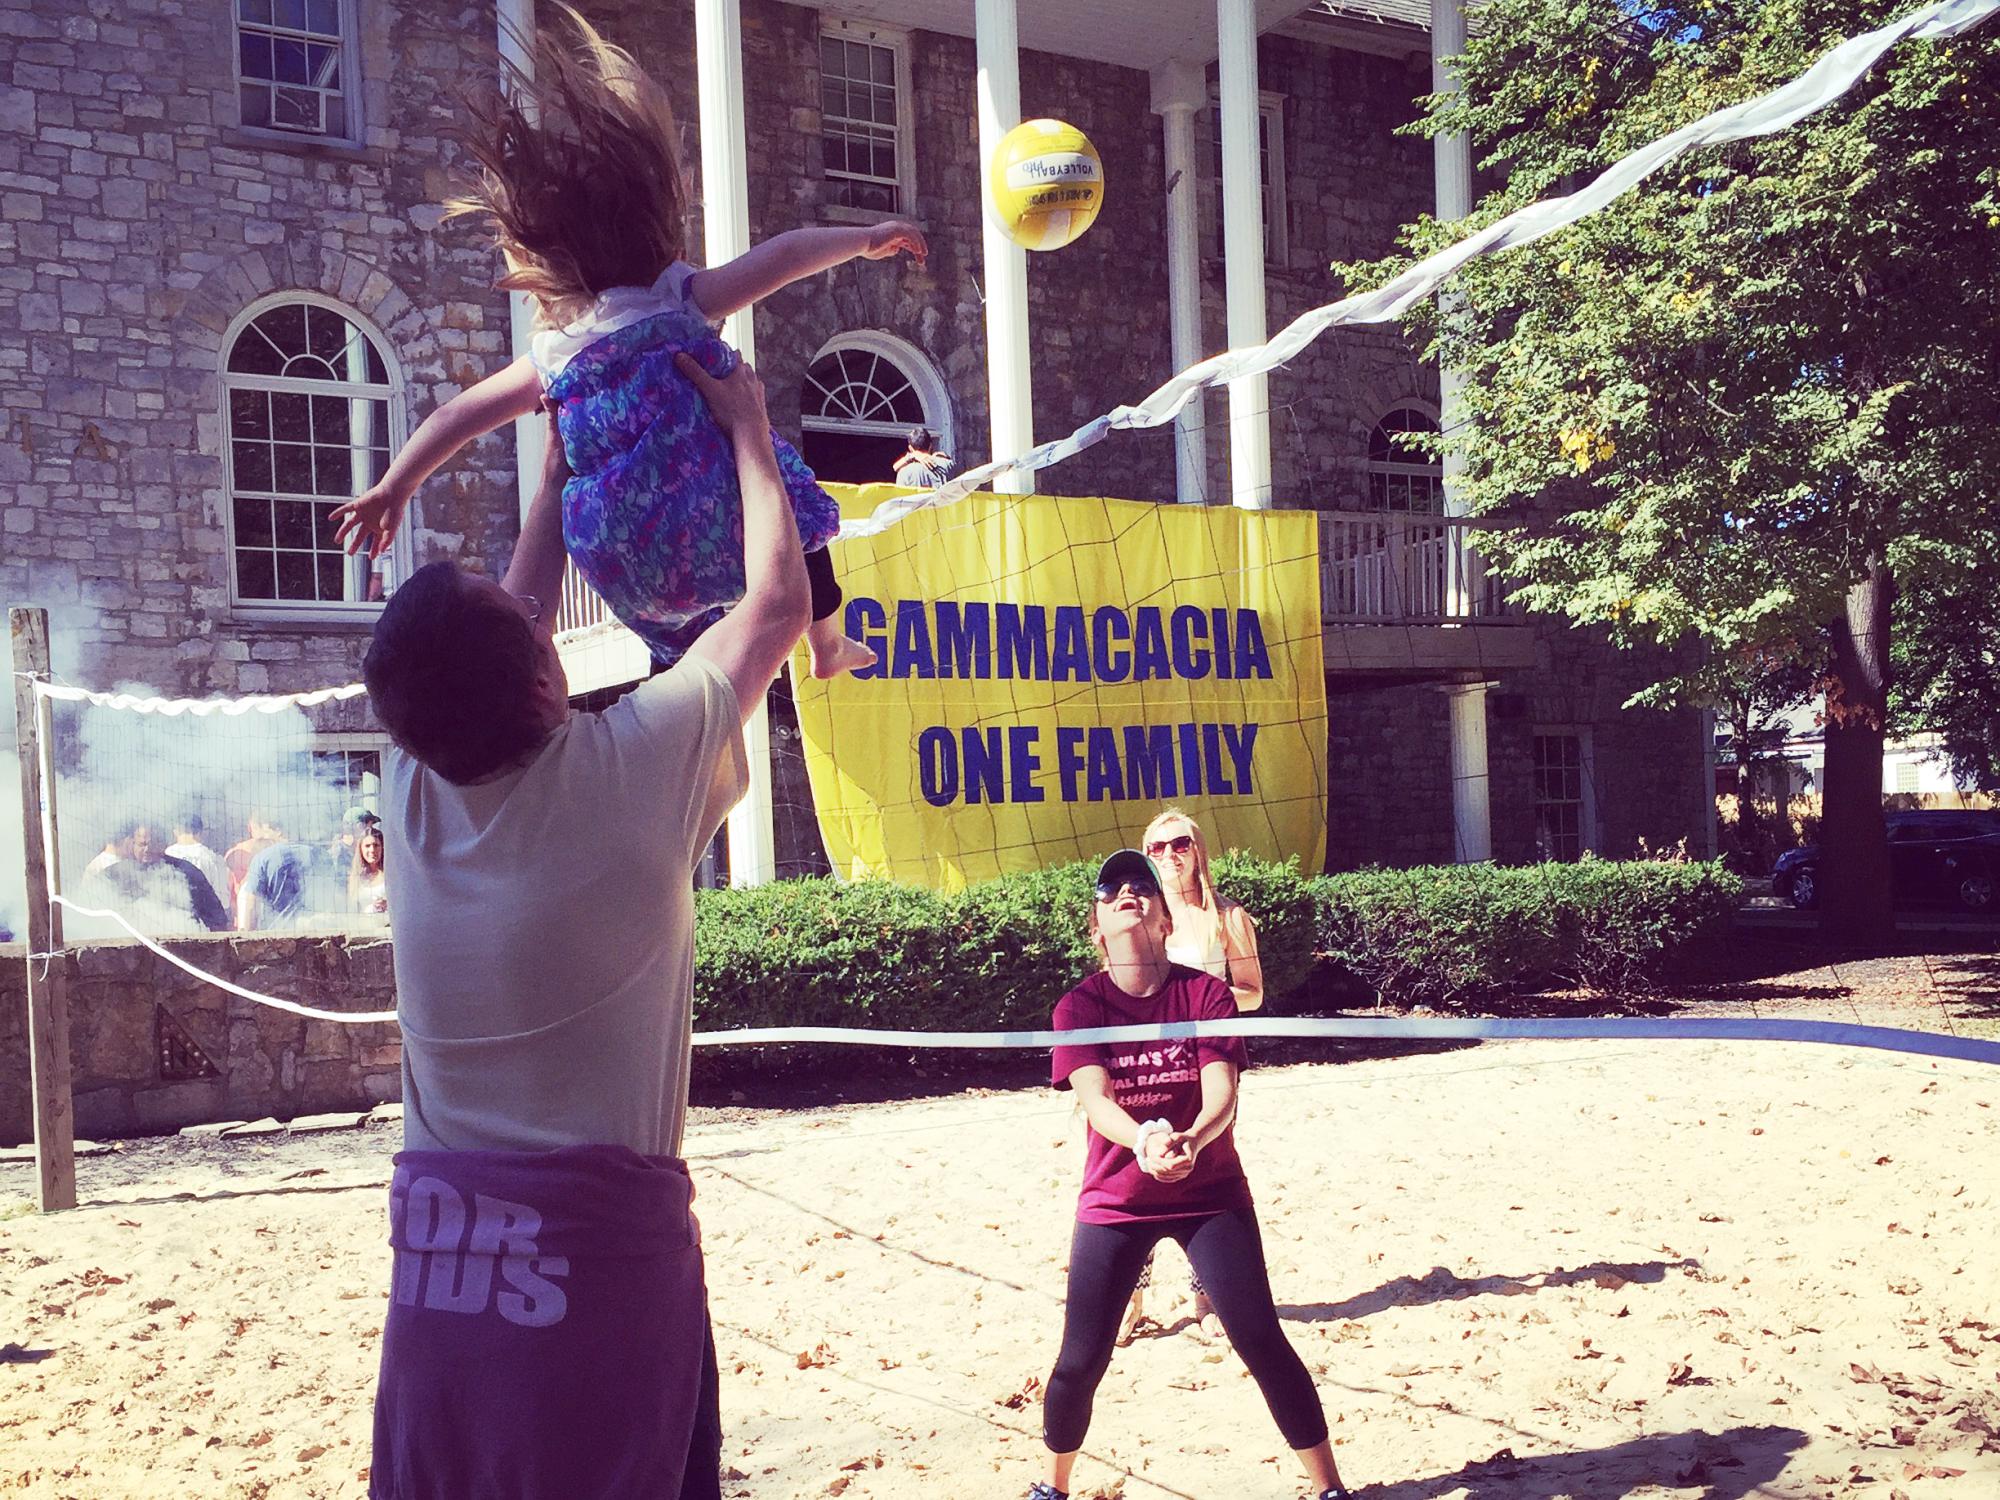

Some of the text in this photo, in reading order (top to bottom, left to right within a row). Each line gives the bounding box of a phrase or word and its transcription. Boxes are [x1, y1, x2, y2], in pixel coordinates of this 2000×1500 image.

[844, 596, 1274, 683] GAMMACACIA
[918, 722, 1259, 808] ONE FAMILY
[1137, 1067, 1199, 1087] RACERS
